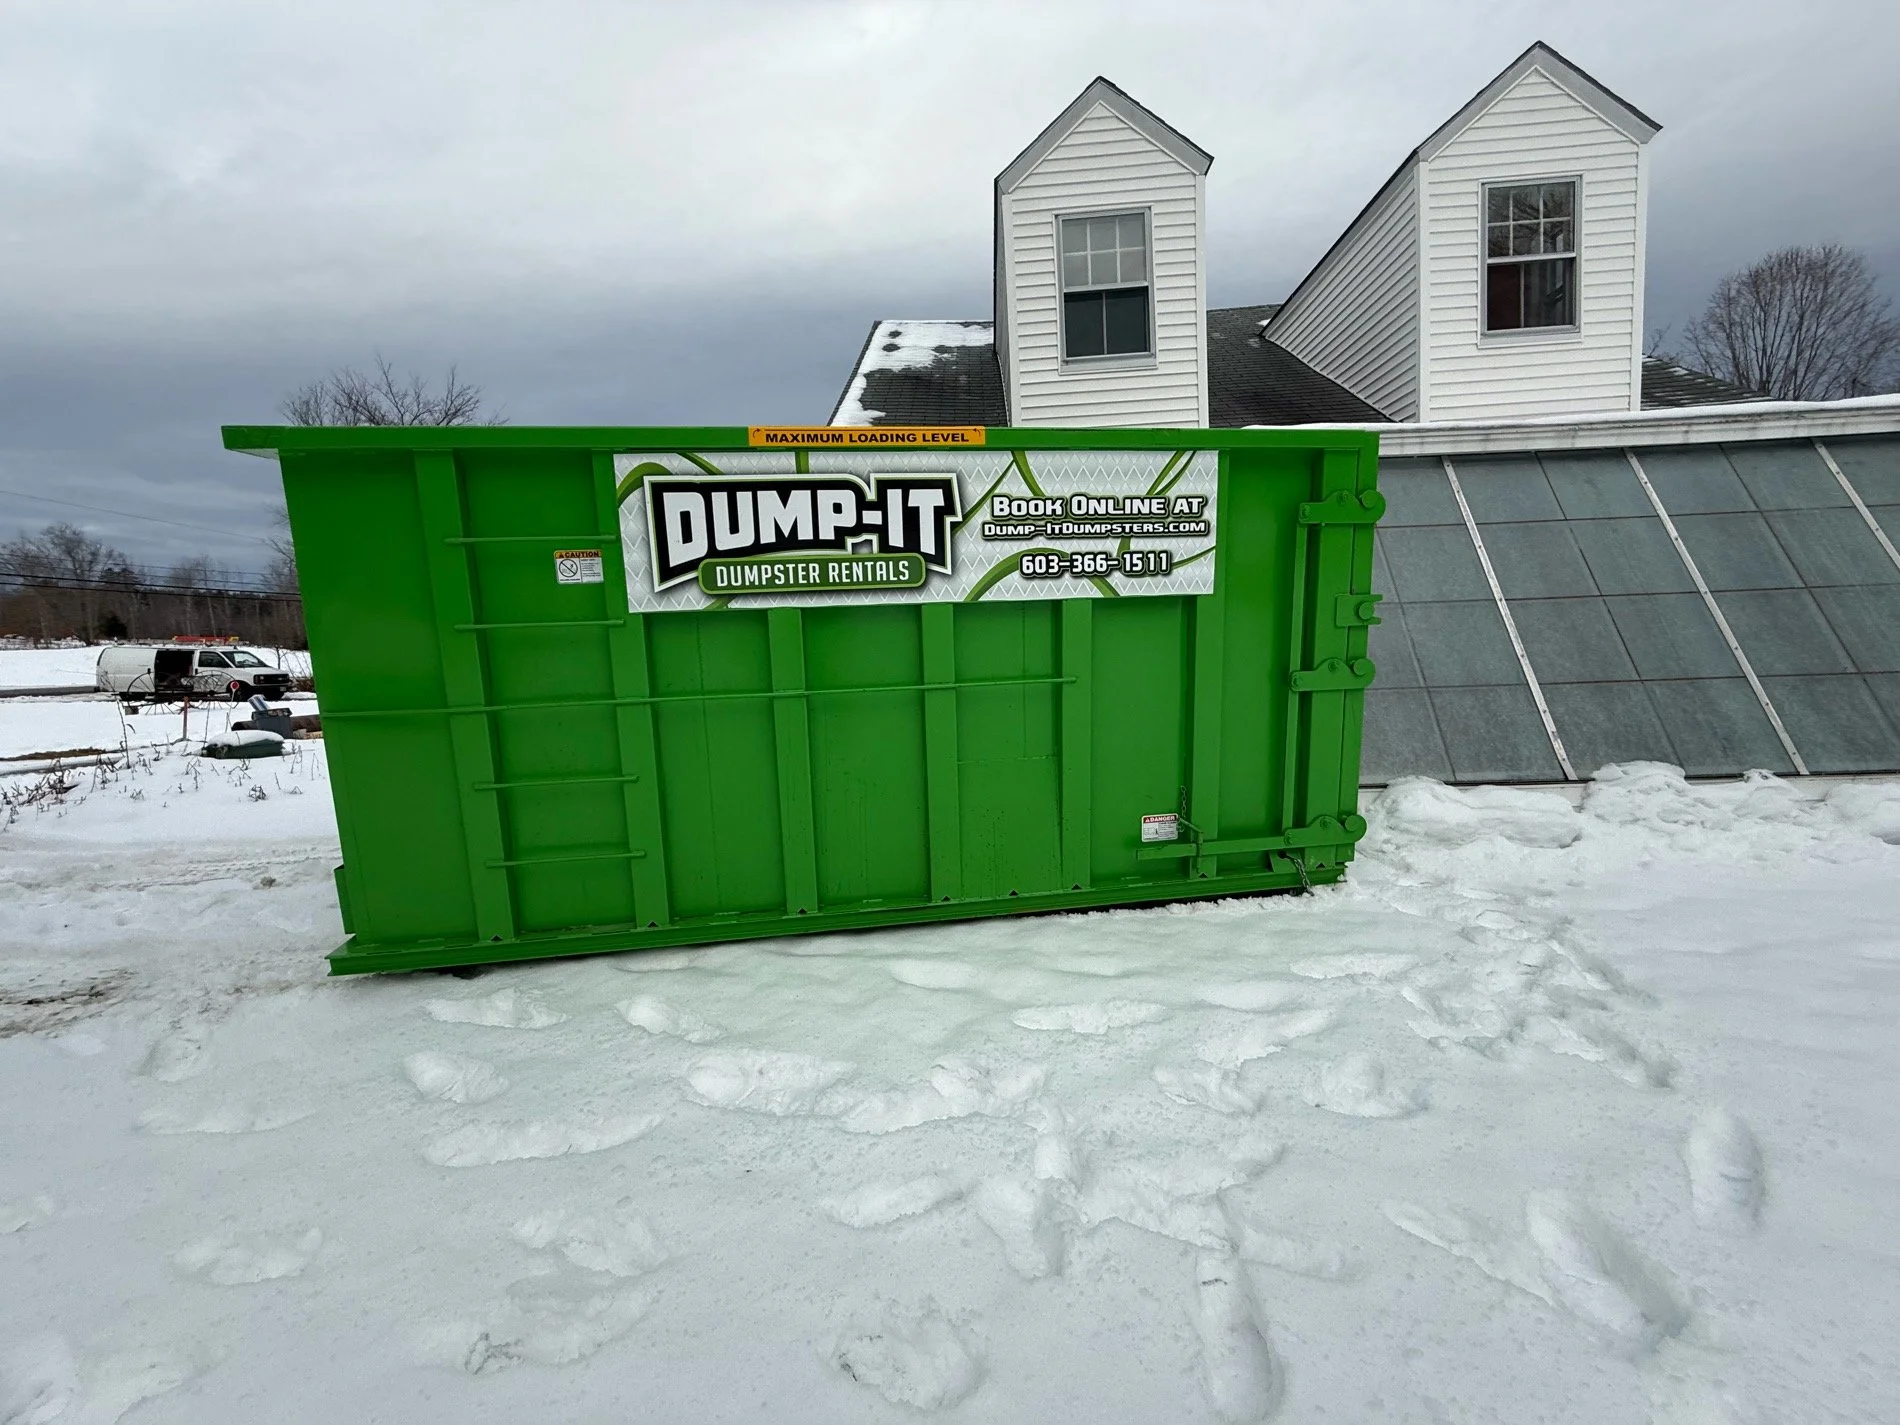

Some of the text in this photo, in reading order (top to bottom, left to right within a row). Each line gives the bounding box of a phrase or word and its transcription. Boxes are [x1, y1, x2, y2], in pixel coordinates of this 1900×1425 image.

[765, 432, 969, 444] MAXIMUM LOADING LEVEL
[662, 488, 945, 568] DUMP-IT
[716, 560, 910, 587] DUMPSTER RENTALS
